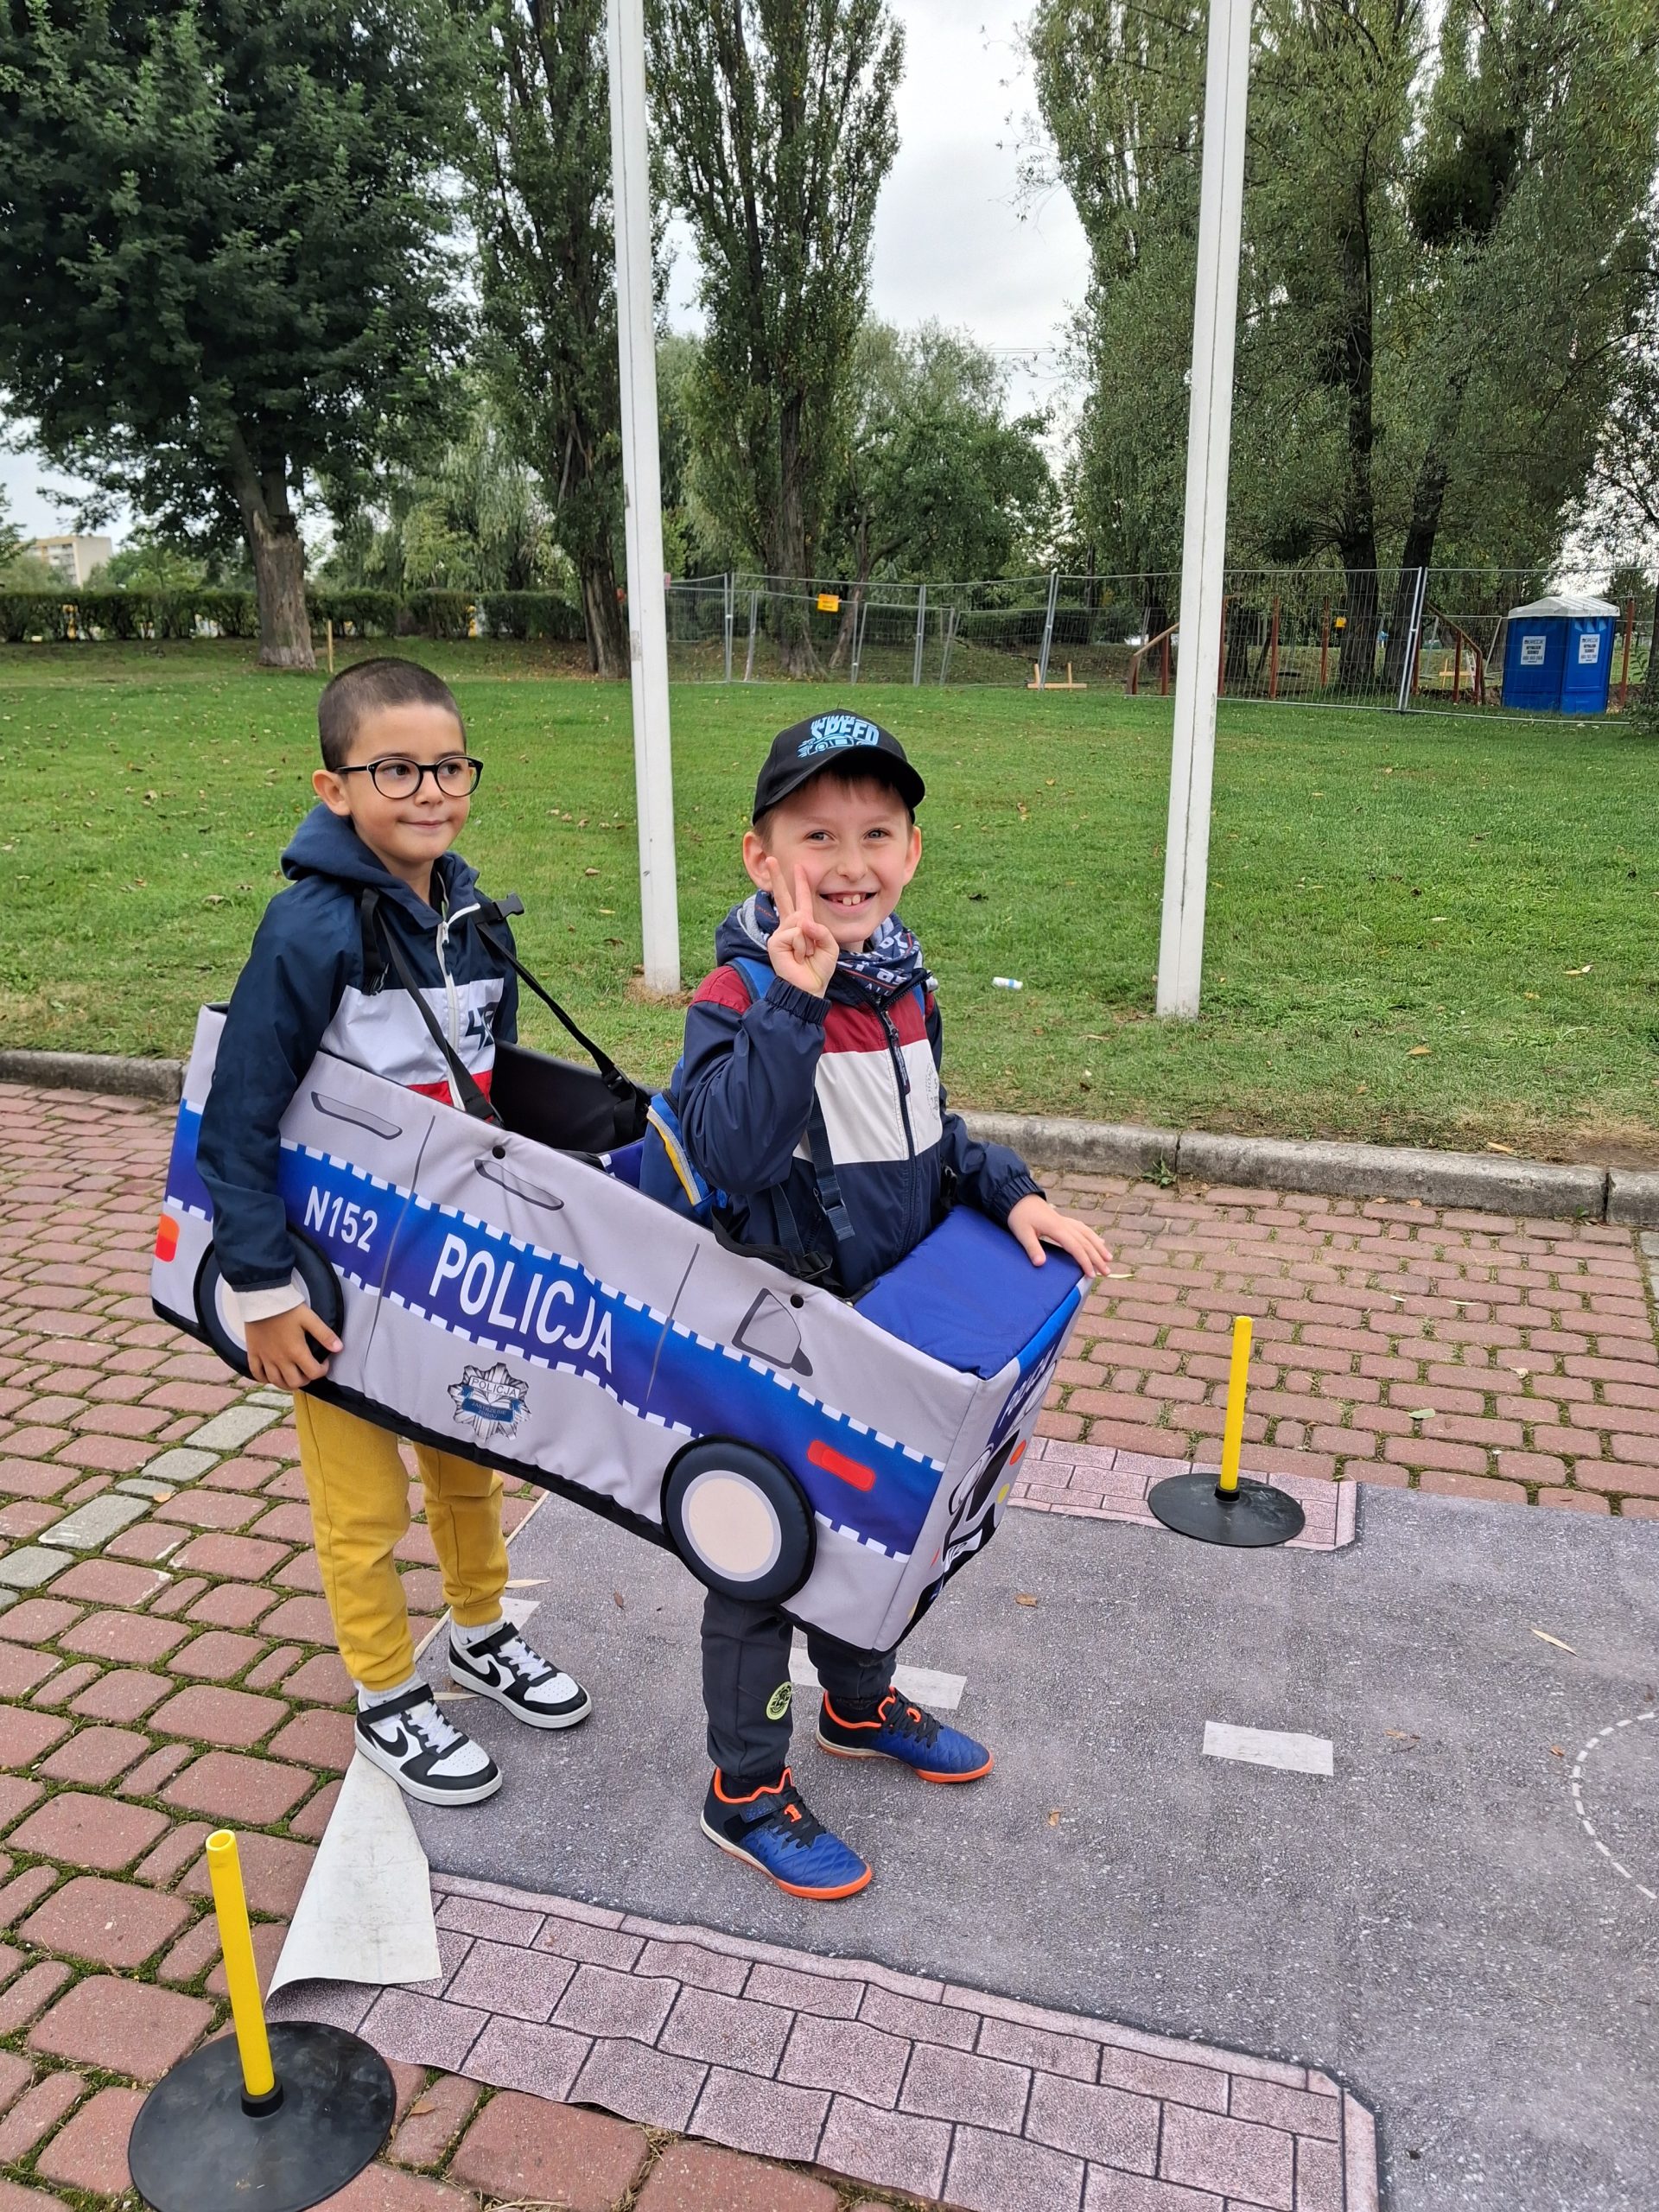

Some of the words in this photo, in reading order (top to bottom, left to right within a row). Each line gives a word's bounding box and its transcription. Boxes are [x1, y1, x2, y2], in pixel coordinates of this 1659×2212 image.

[810, 717, 880, 746] SPEED
[303, 1185, 378, 1253] N152
[429, 1233, 613, 1374] POLICJA
[471, 1377, 517, 1398] POLICJA
